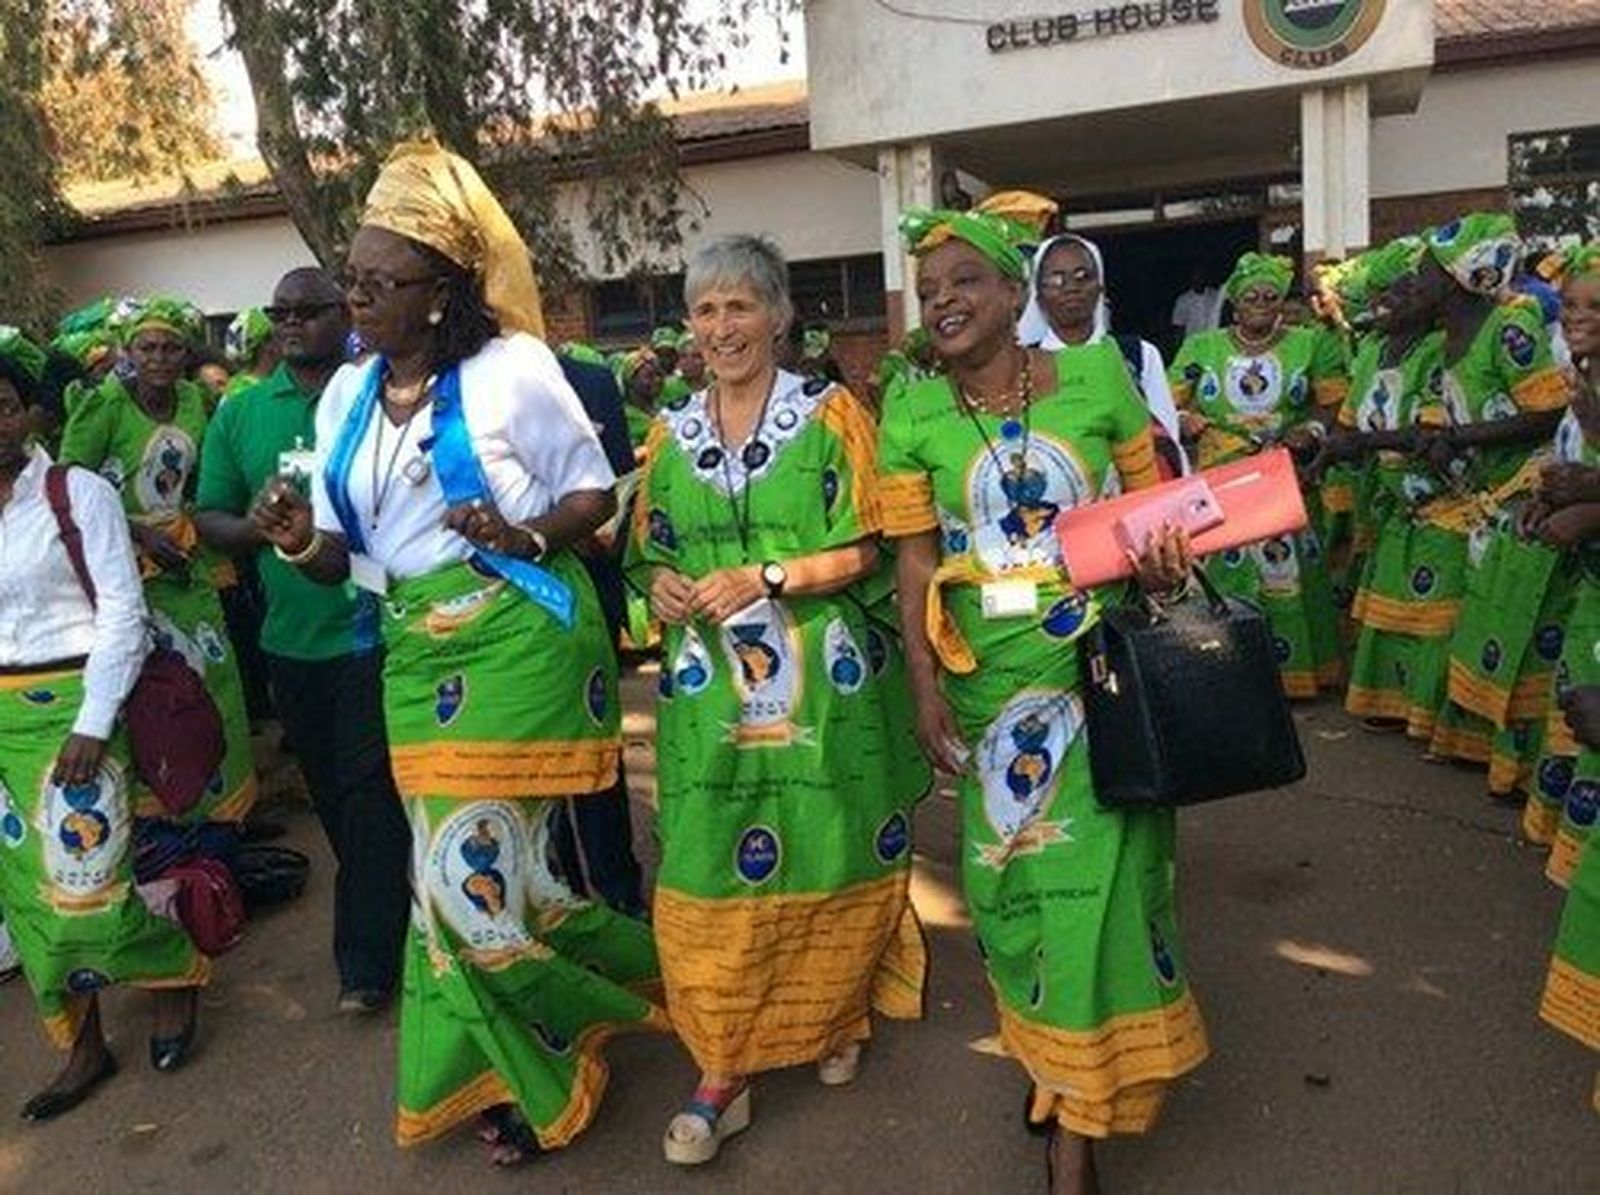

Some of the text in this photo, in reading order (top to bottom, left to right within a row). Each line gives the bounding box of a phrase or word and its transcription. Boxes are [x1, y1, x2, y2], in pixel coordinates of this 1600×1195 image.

[987, 0, 1219, 50] CLUB HOUSE
[1280, 41, 1349, 68] CLUB
